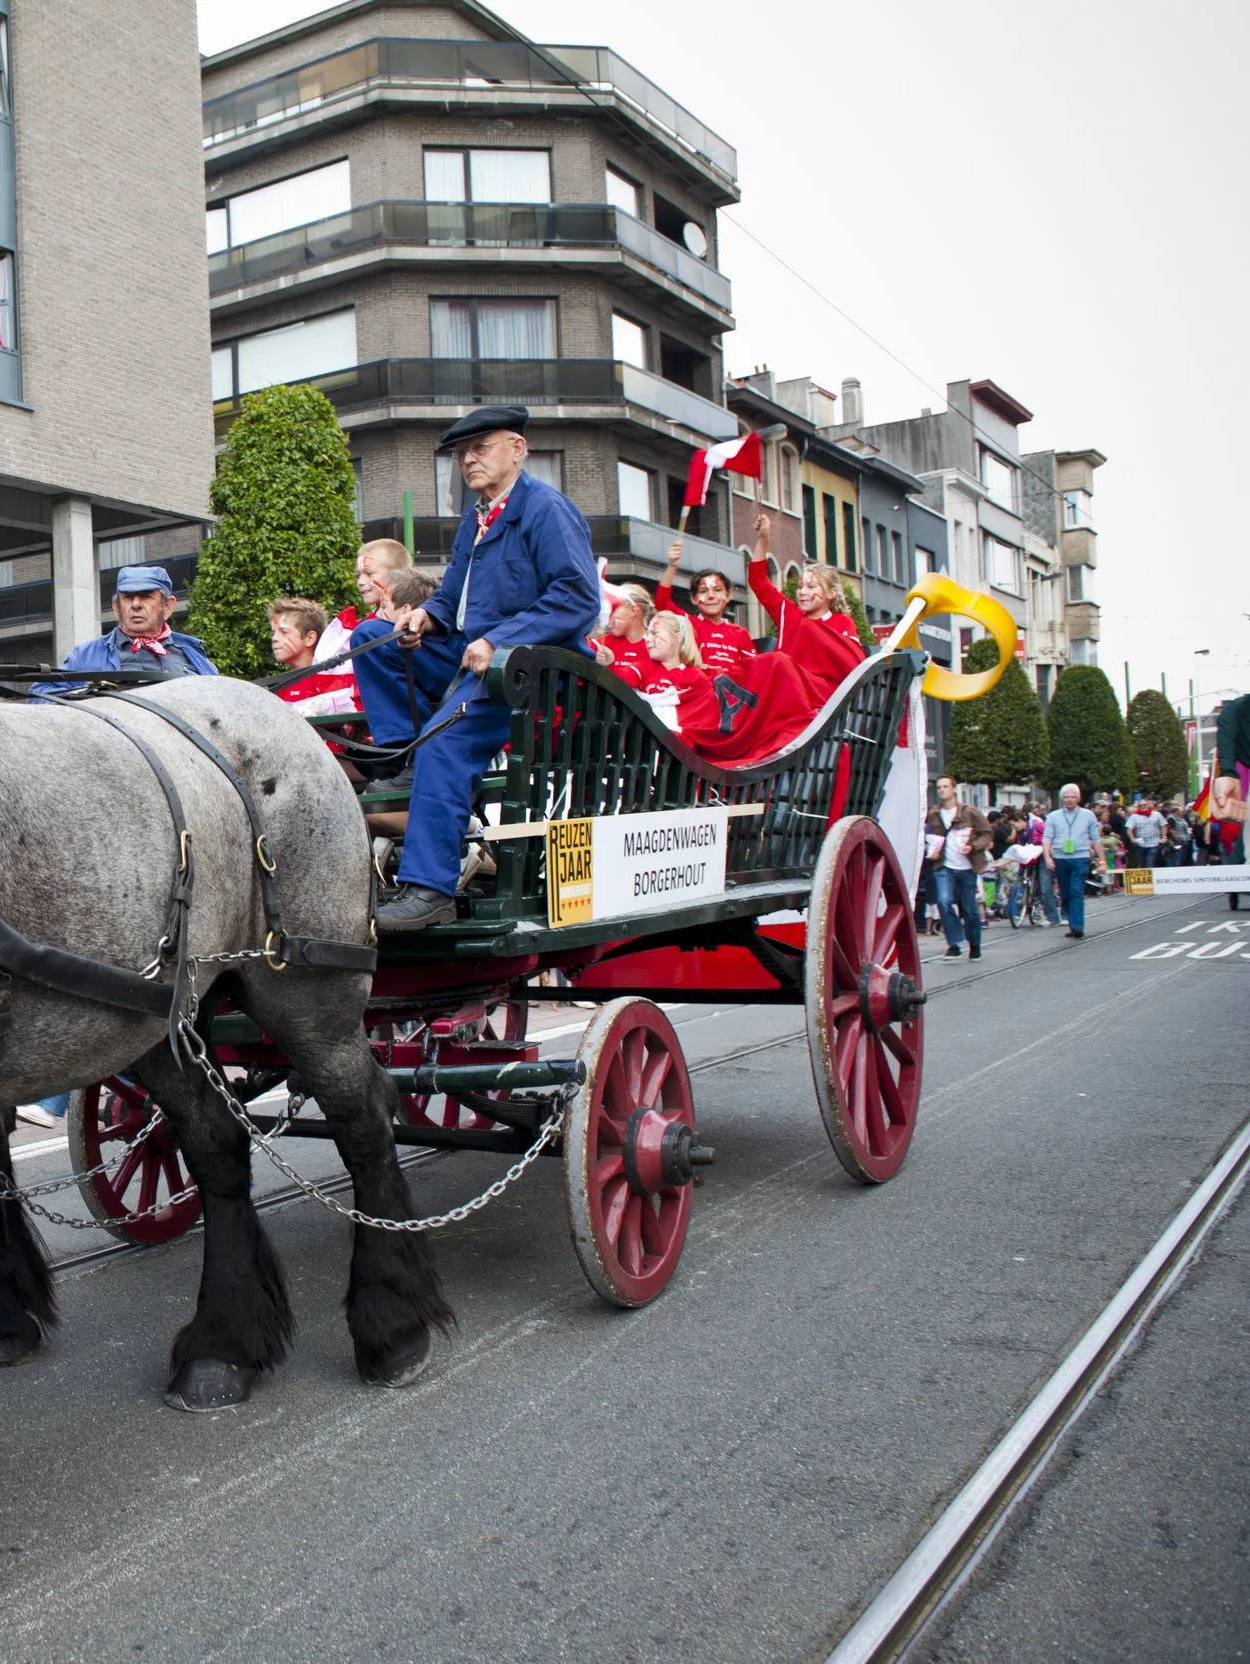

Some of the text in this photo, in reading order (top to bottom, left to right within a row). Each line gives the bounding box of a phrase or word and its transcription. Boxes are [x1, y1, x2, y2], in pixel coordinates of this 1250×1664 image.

[623, 823, 718, 857] MAAGDENWAGEN
[560, 849, 592, 883] JAAR
[633, 862, 707, 897] BORGERHOUT
[1132, 876, 1153, 885] JAAR
